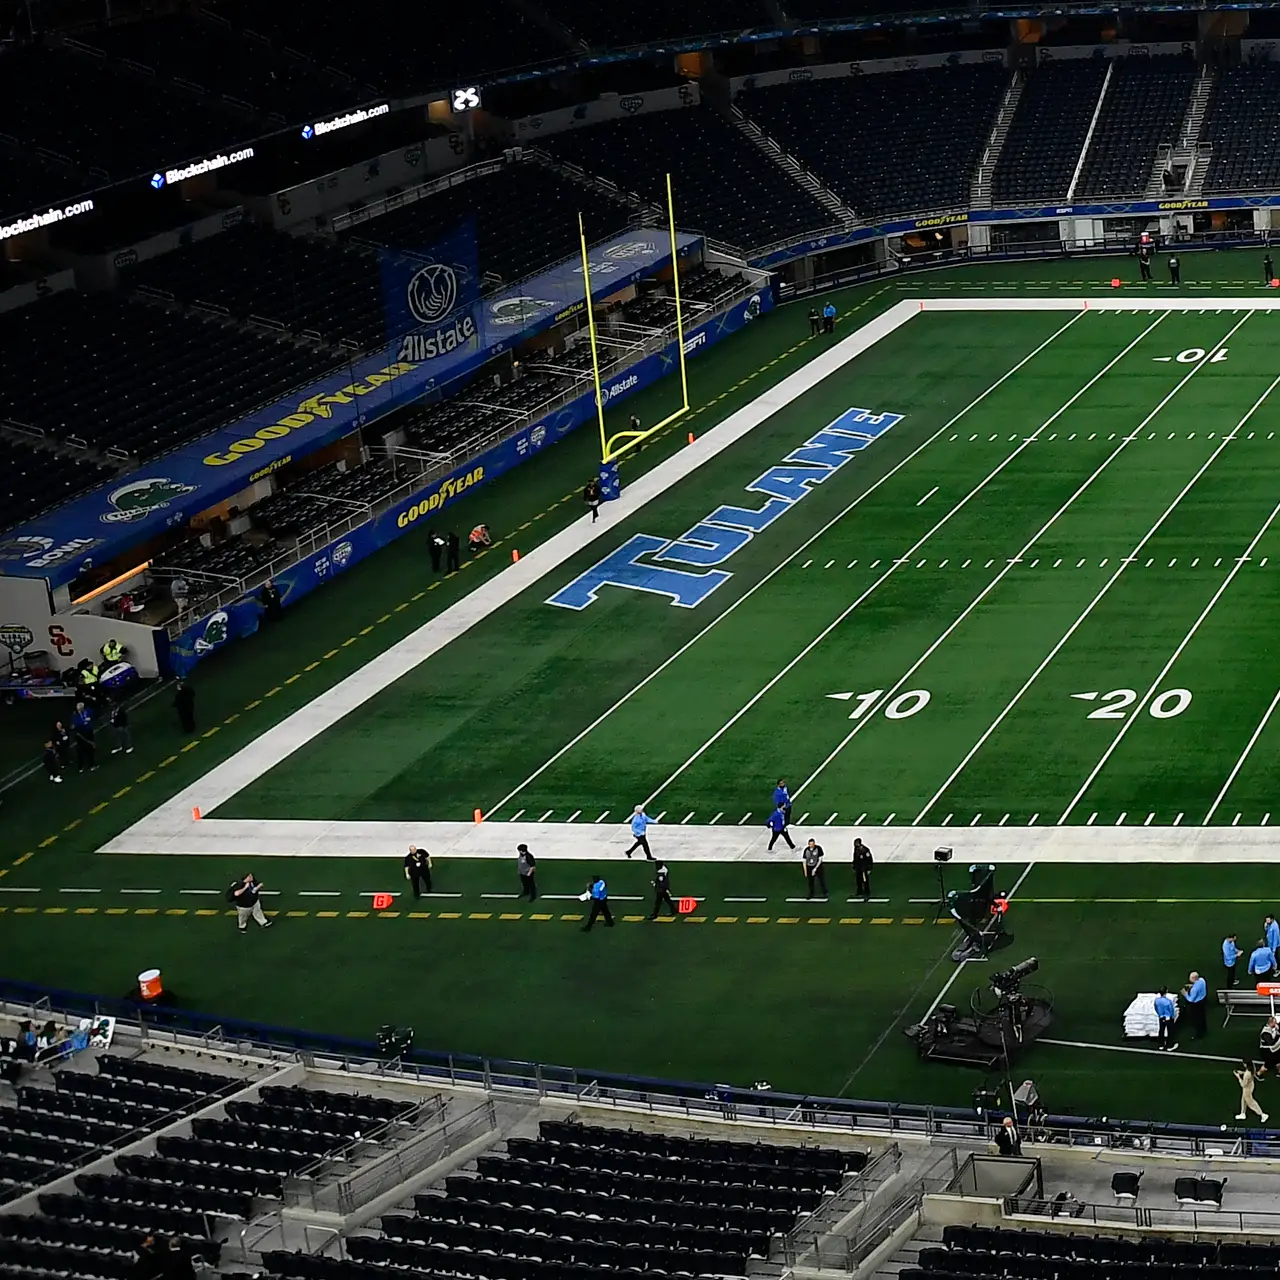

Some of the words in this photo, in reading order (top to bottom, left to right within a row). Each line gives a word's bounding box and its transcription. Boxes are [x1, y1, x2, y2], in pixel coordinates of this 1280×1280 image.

[453, 87, 480, 110] 25
[314, 102, 389, 136] Blockchain.com
[165, 146, 254, 185] Blockchain.com
[1158, 200, 1208, 209] GOODYEAR
[915, 214, 968, 227] GOODYEAR
[397, 315, 475, 362] Allstate
[609, 374, 638, 399] Allstate
[203, 361, 419, 466] GOODYEAR
[249, 455, 292, 481] GOODYEAR
[398, 466, 484, 528] GOODYEAR
[543, 407, 906, 611] TULANE
[26, 536, 95, 568] BOWL
[846, 688, 932, 719] 10
[1090, 688, 1194, 719] 20
[376, 895, 385, 907] G
[681, 900, 690, 911] 10
